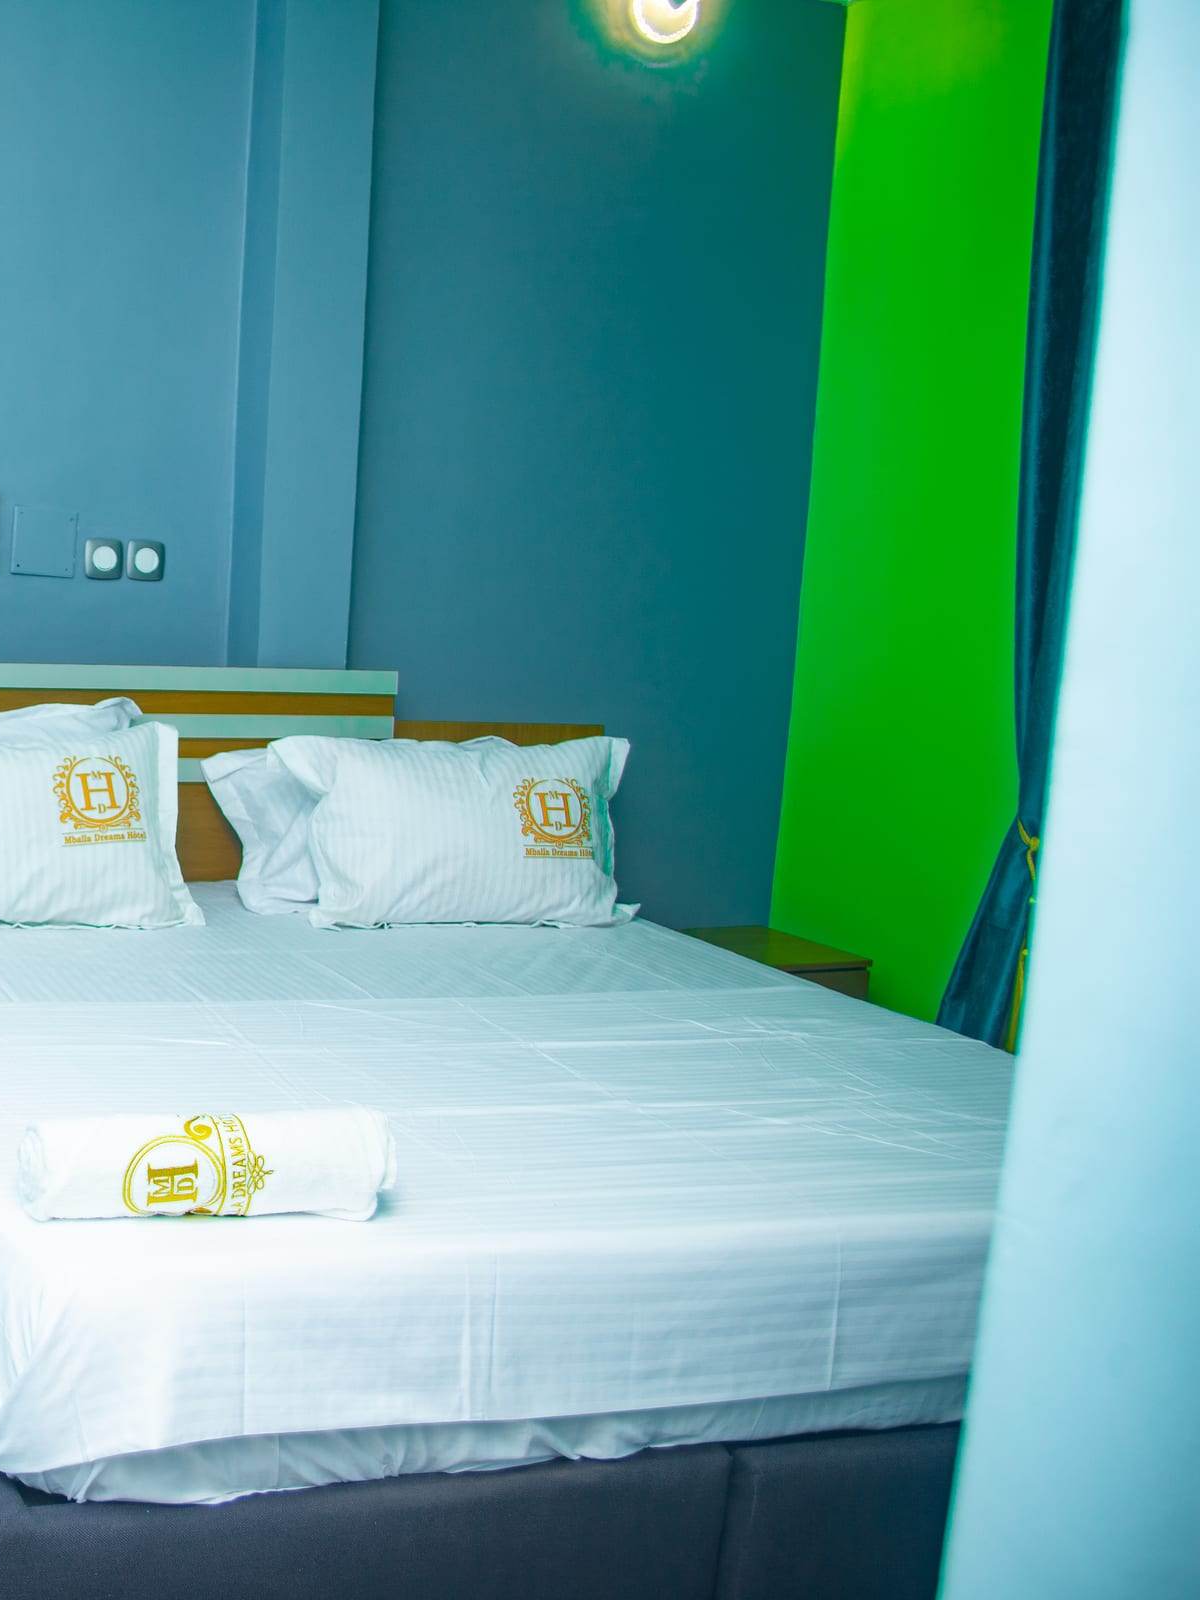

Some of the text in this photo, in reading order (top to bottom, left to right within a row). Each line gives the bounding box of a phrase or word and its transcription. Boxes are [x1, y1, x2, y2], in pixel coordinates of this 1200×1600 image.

[75, 771, 121, 810] H
[534, 792, 576, 827] H
[95, 833, 125, 843] Dreams
[551, 847, 577, 857] Dreams
[147, 1157, 199, 1206] H
[229, 1137, 247, 1200] DREAMS
